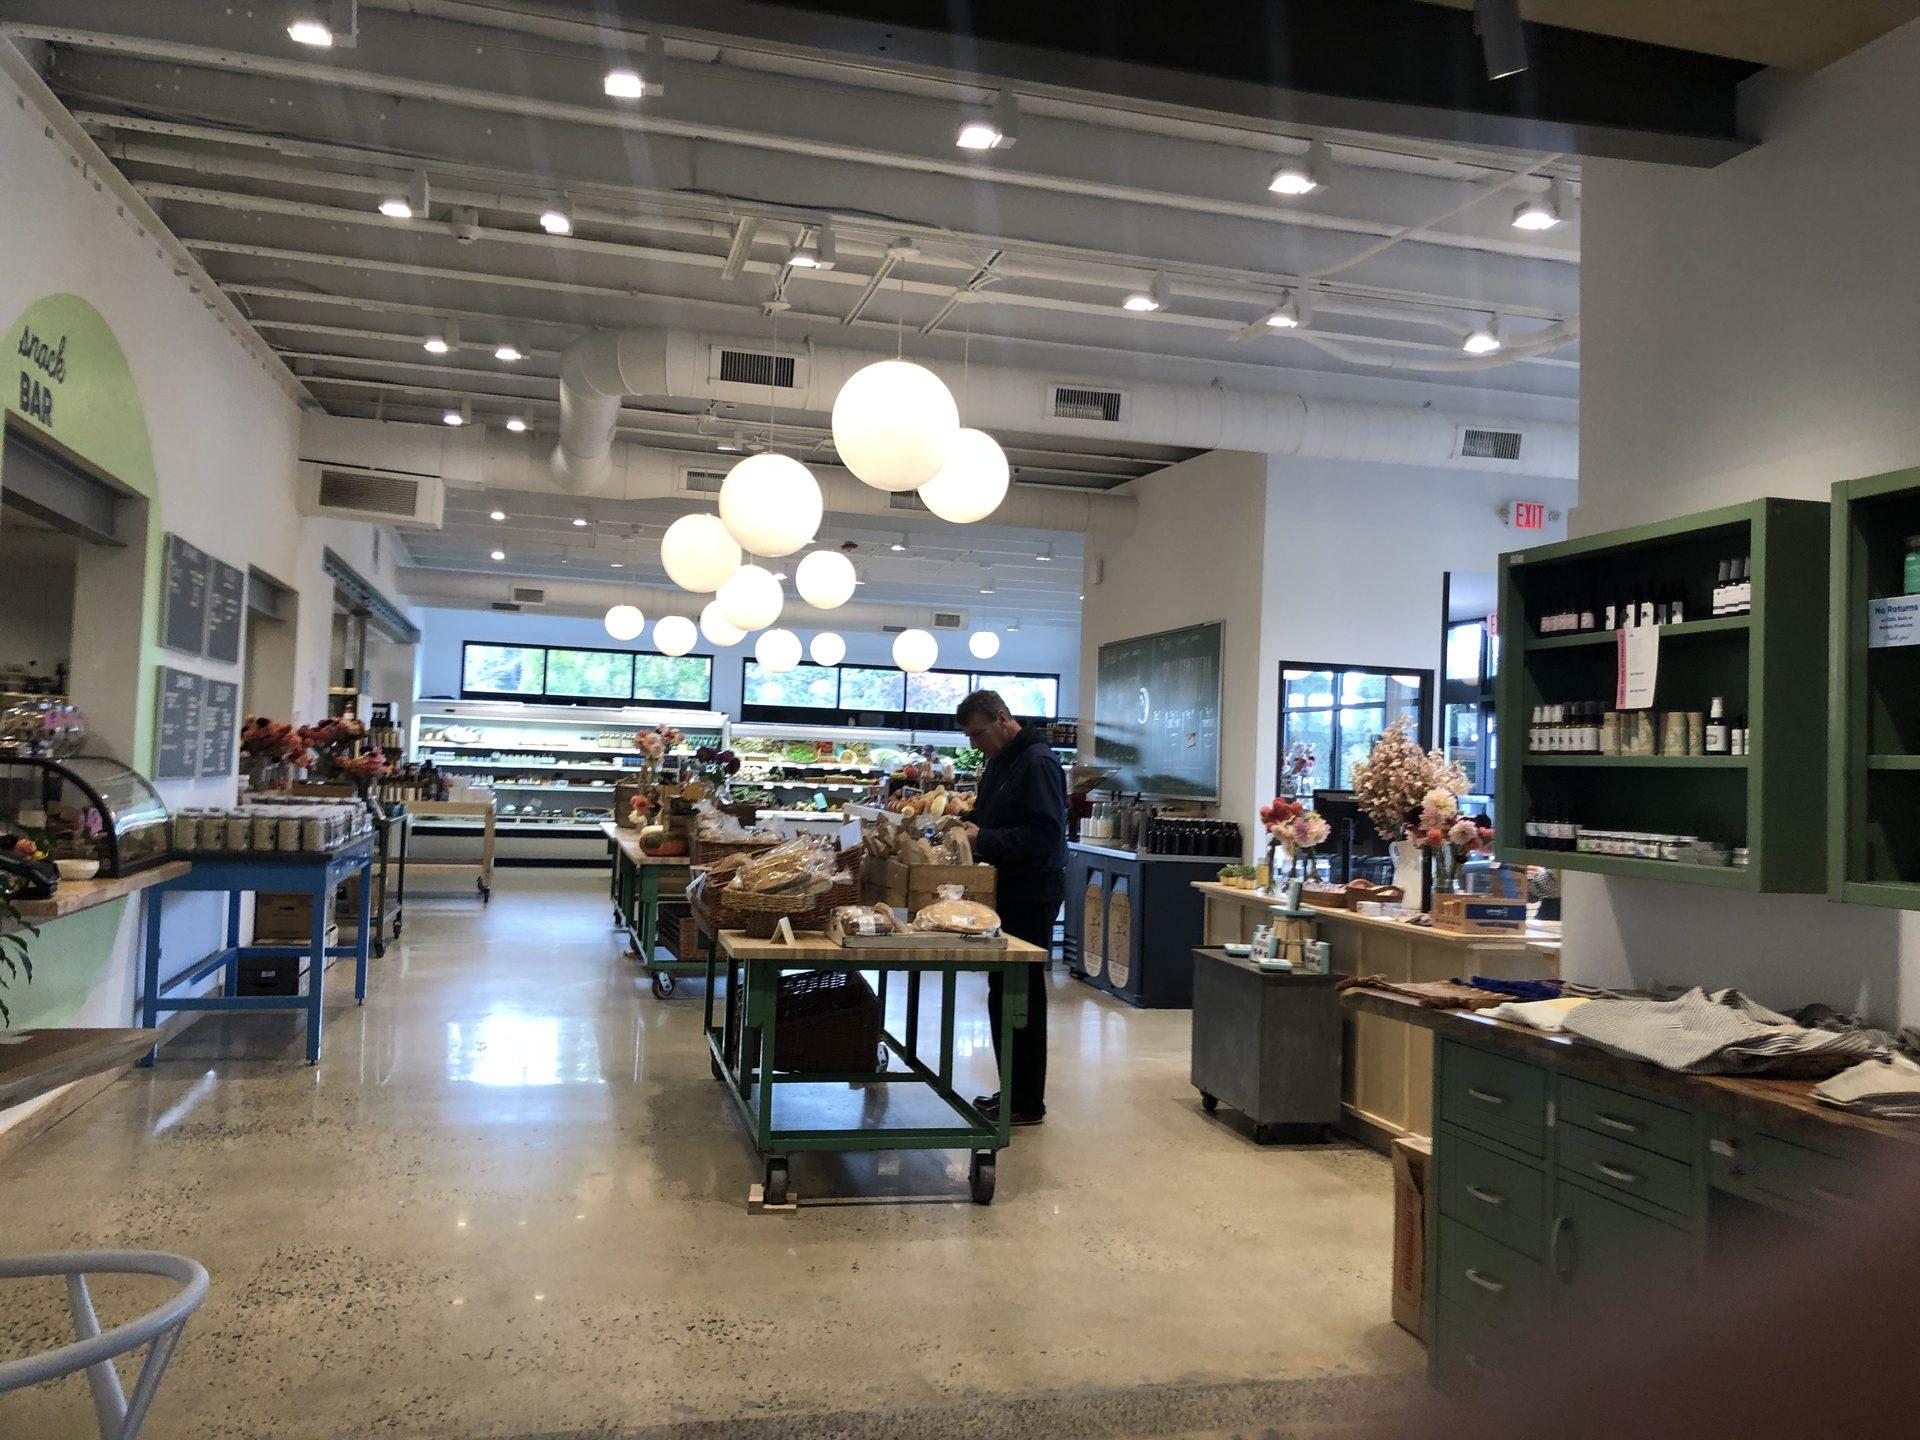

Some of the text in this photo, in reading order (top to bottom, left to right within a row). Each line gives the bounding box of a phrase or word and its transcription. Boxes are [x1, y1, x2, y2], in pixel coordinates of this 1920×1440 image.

[19, 371, 53, 428] BAR
[1515, 503, 1544, 528] EXIT
[1875, 604, 1919, 615] No Returns
